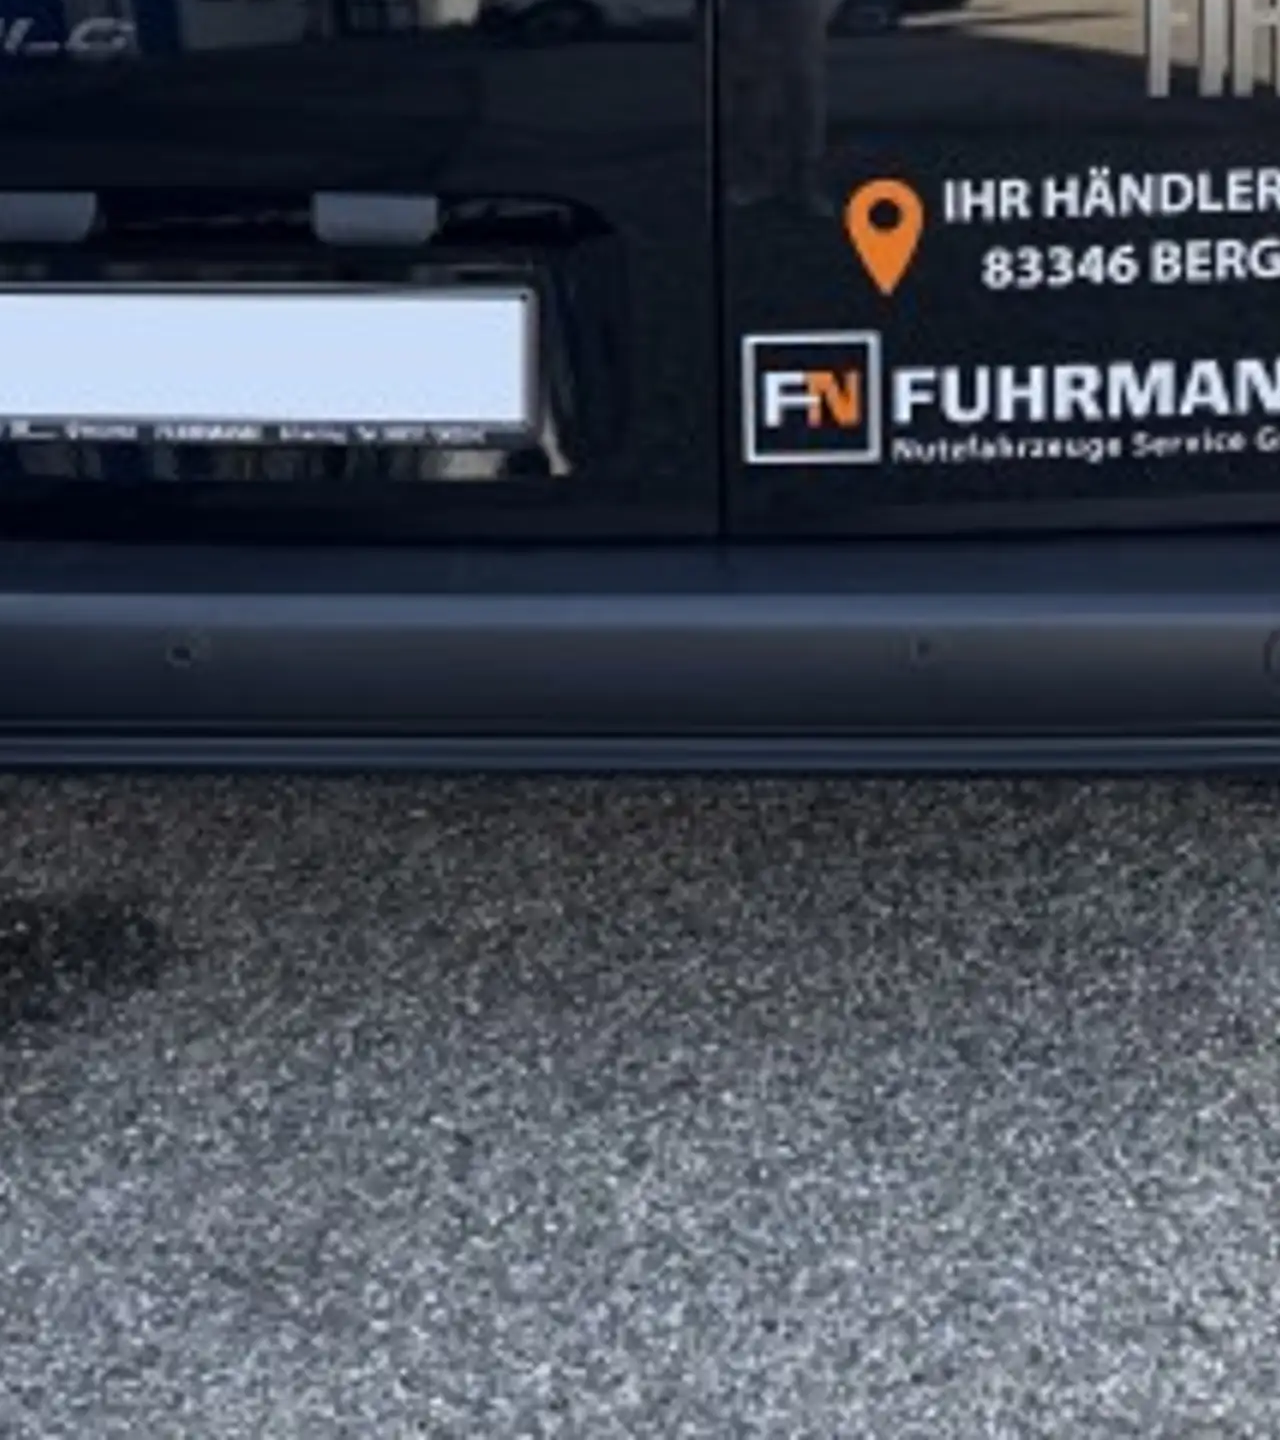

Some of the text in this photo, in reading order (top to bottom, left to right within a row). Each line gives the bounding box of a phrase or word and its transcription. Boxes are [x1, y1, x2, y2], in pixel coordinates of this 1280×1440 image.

[944, 178, 1032, 222] IHR
[981, 244, 1139, 290] 83346
[763, 369, 862, 429] FN
[1130, 427, 1247, 459] Service
